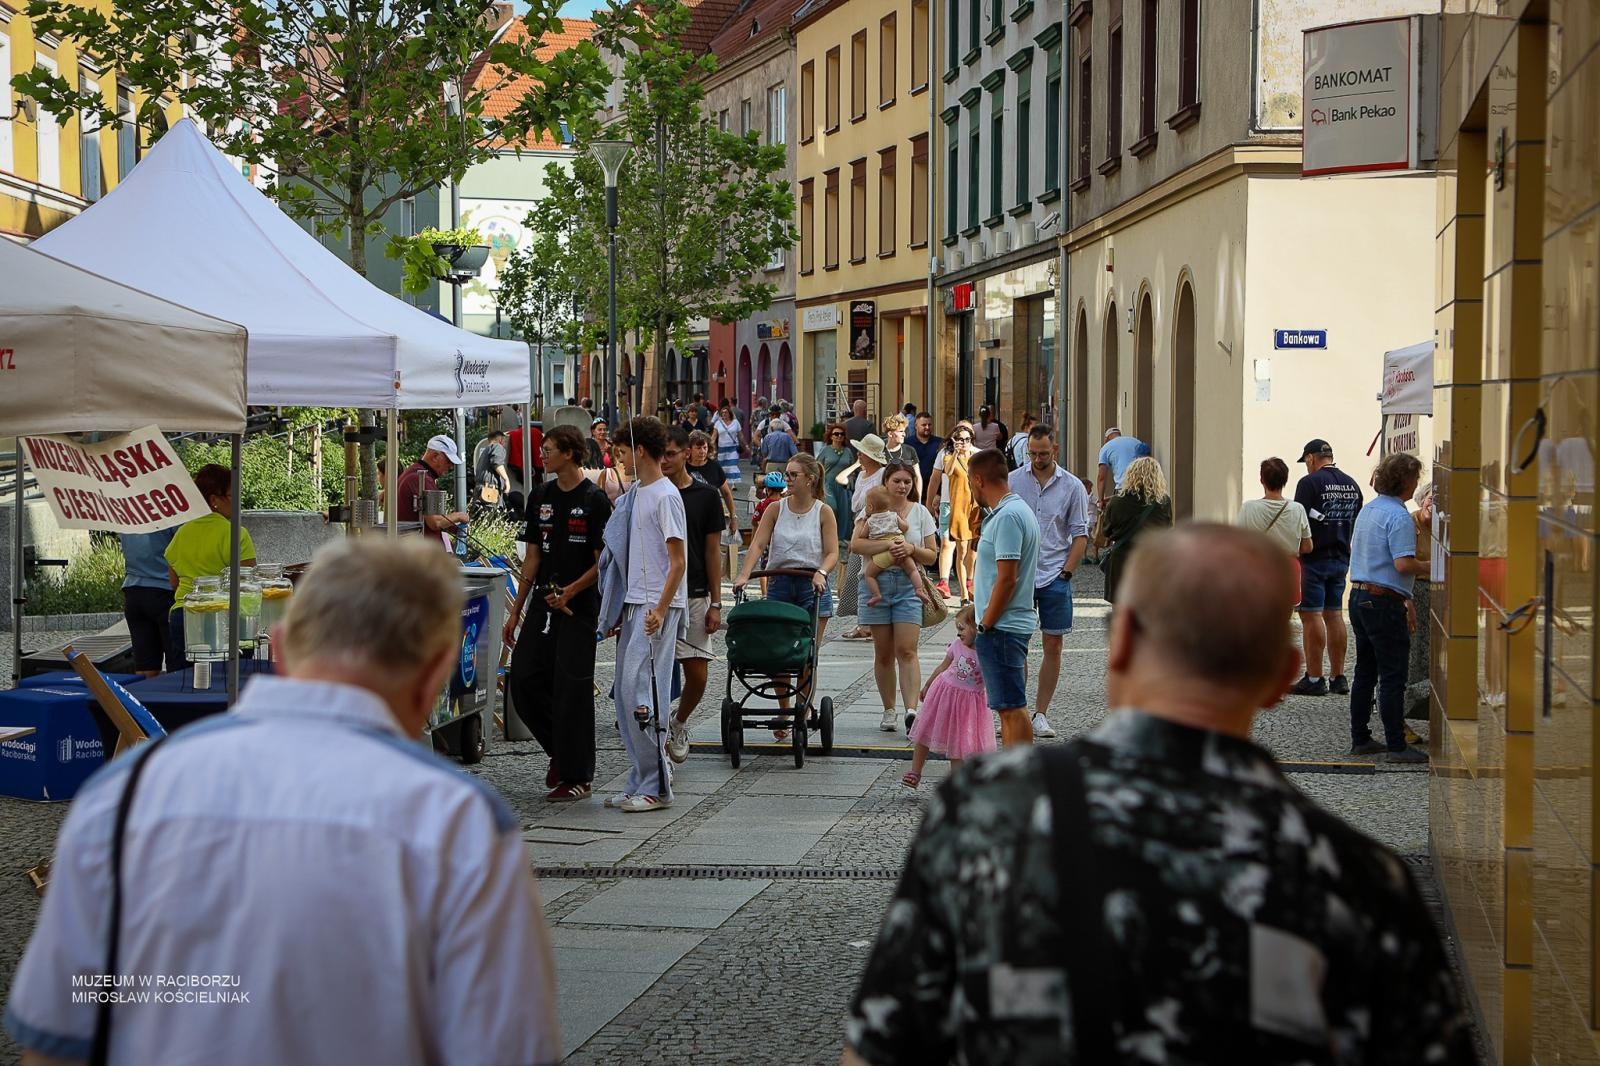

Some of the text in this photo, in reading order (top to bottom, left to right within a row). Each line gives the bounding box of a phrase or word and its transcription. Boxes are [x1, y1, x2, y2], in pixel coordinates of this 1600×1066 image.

[1314, 66, 1393, 90] BANKOMAT
[1331, 104, 1396, 122] Bank Pekao
[1283, 331, 1320, 345] Bankowa
[25, 437, 173, 488] MUZEUM ŚLĄSKA
[53, 483, 190, 525] CIESZYŃSKIEGO
